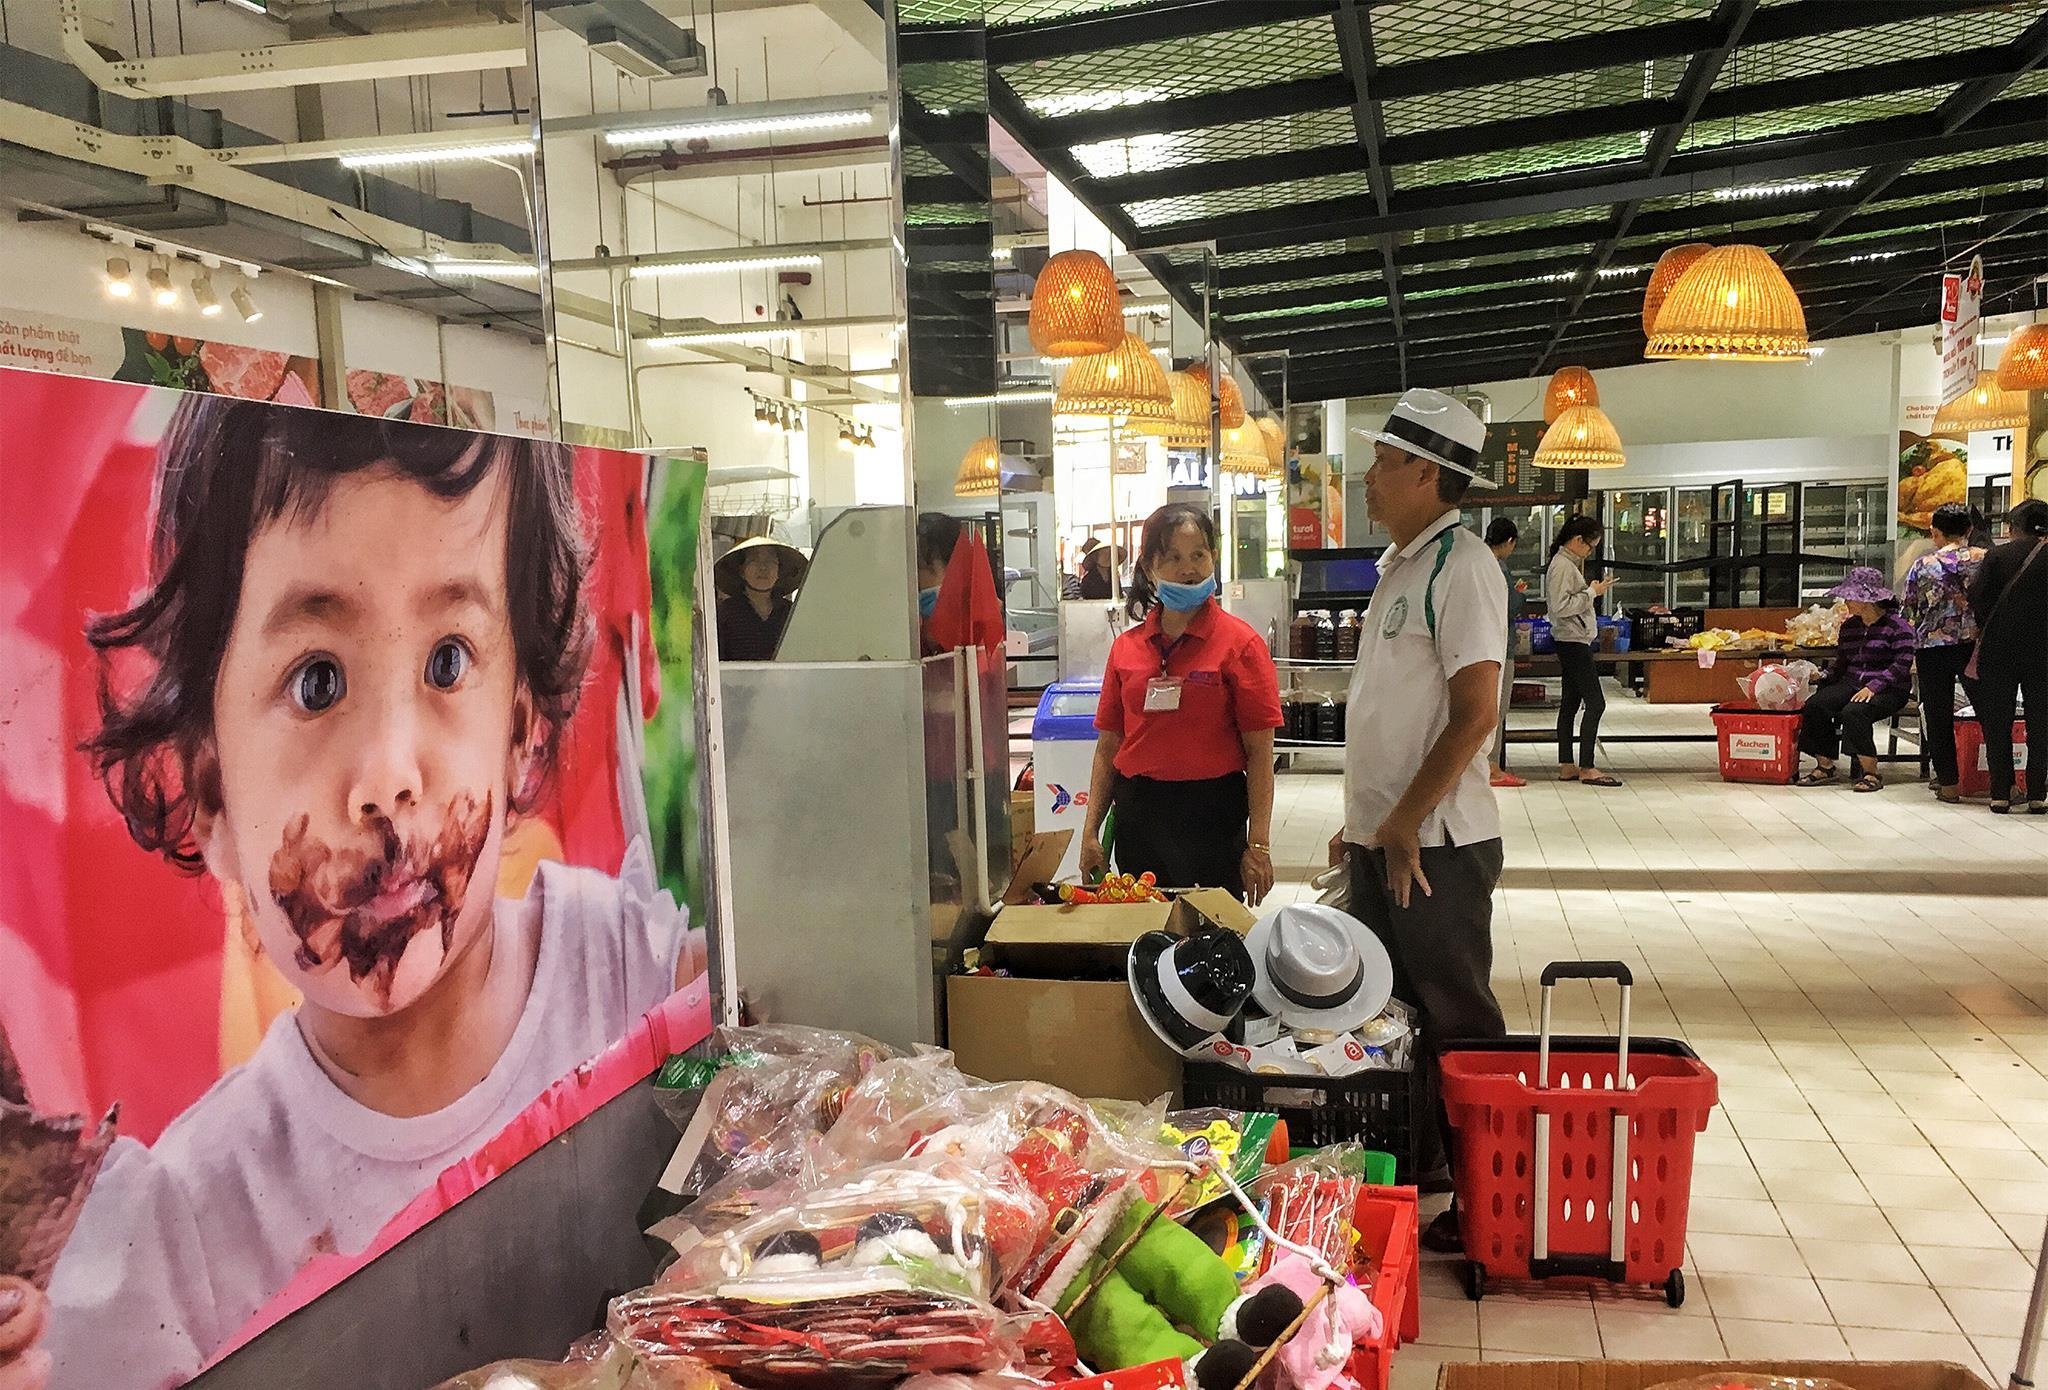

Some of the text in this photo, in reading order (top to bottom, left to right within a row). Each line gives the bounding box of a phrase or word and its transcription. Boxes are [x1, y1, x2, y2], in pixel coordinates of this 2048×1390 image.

[22, 323, 55, 340] phẩm
[0, 339, 15, 356] ất
[18, 343, 54, 364] lượng
[1507, 443, 1518, 484] MENU
[1735, 738, 1770, 749] Auchan
